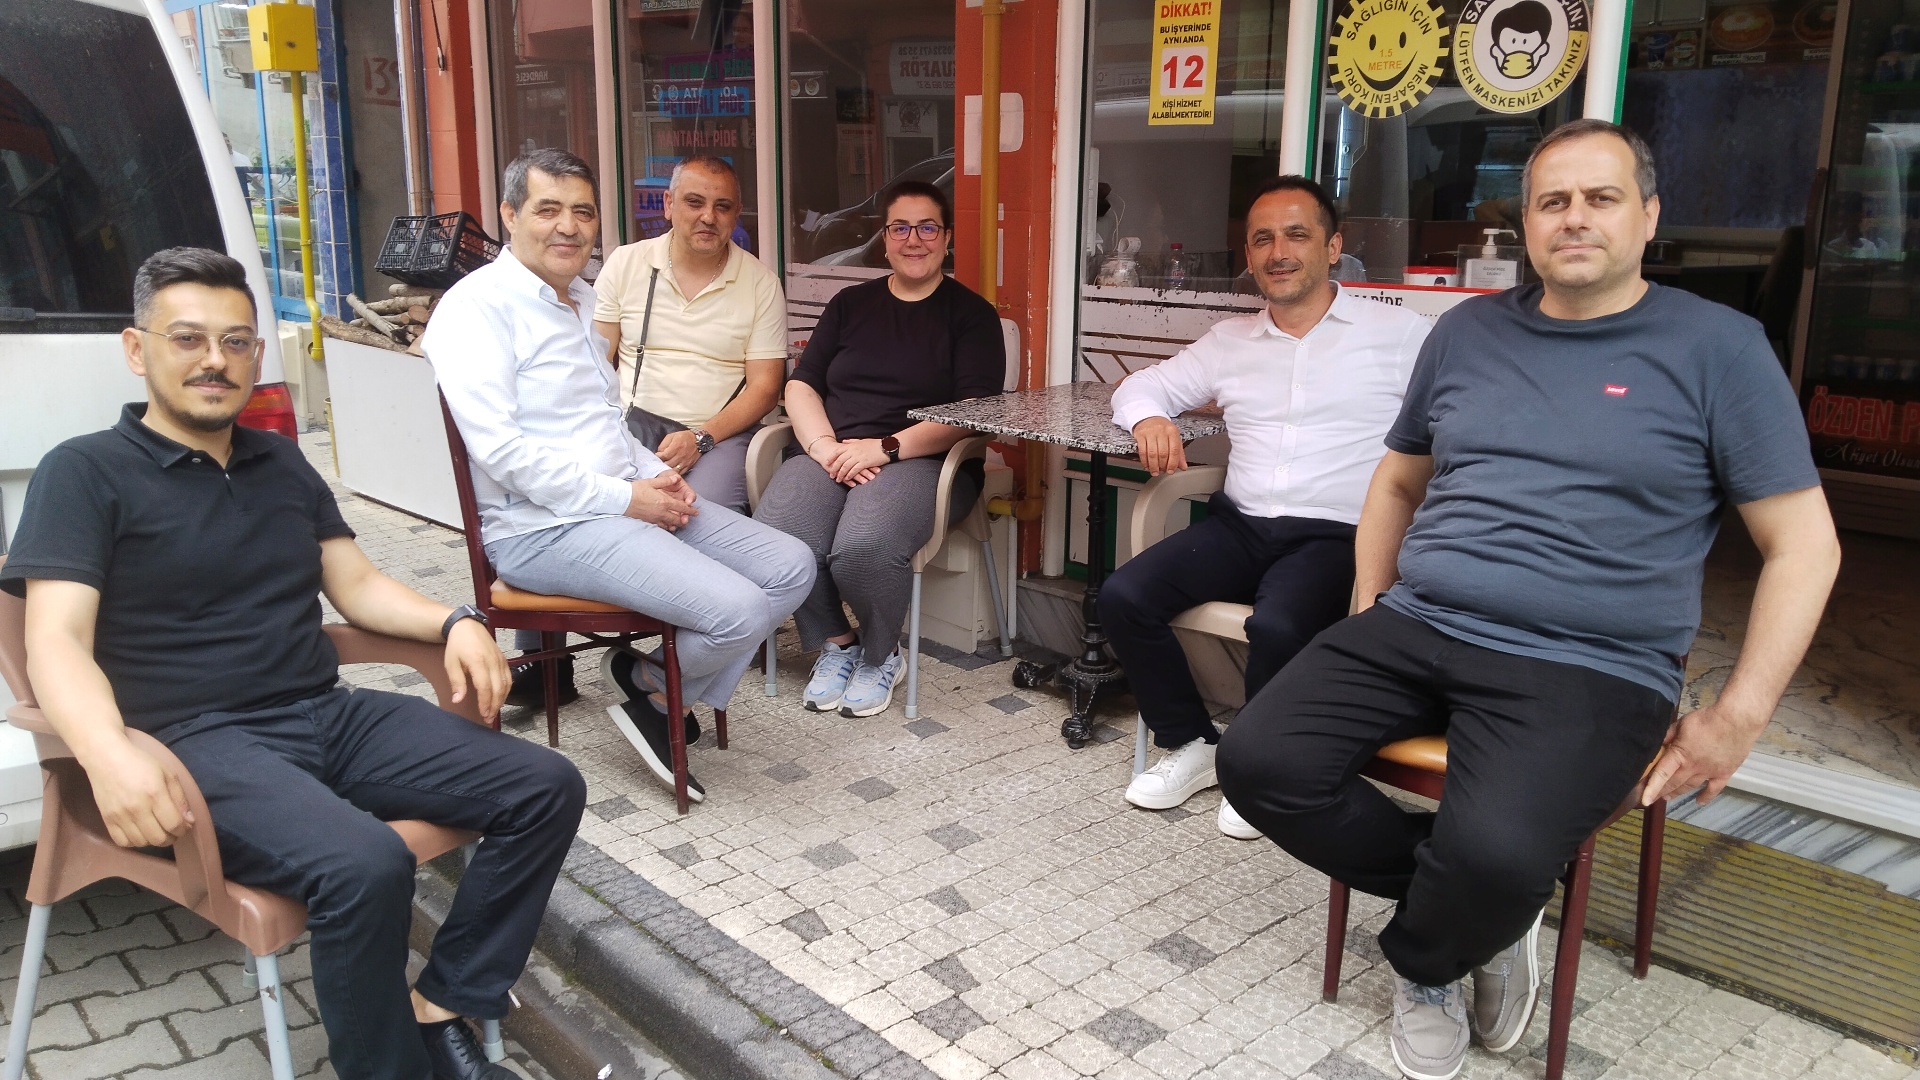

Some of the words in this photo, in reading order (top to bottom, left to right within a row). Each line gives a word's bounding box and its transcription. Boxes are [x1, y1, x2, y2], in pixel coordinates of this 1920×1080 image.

[1161, 1, 1212, 19] DİKKAT!
[1409, 3, 1432, 35] İÇİN
[1160, 26, 1170, 34] BU
[1171, 23, 1212, 35] İŞYERİNDE
[1164, 36, 1182, 45] AYNI
[1183, 35, 1205, 43] ANDA
[1163, 55, 1205, 88] 12
[1368, 60, 1402, 71] METRE
[1458, 31, 1476, 85] LÜTFEN
[1473, 83, 1544, 108] MASKENİZİ
[1344, 67, 1370, 100] KORU
[1370, 63, 1429, 105] MESAFENİ
[1152, 109, 1212, 119] ALABİLMEKTEDİR!
[1162, 99, 1175, 109] KİŞİ
[1177, 98, 1202, 107] HİZMET
[656, 130, 709, 147] MANTARLI
[713, 125, 737, 147] PİDE
[1808, 385, 1893, 440] ÖZDEN
[1824, 441, 1878, 465] Afiyet
